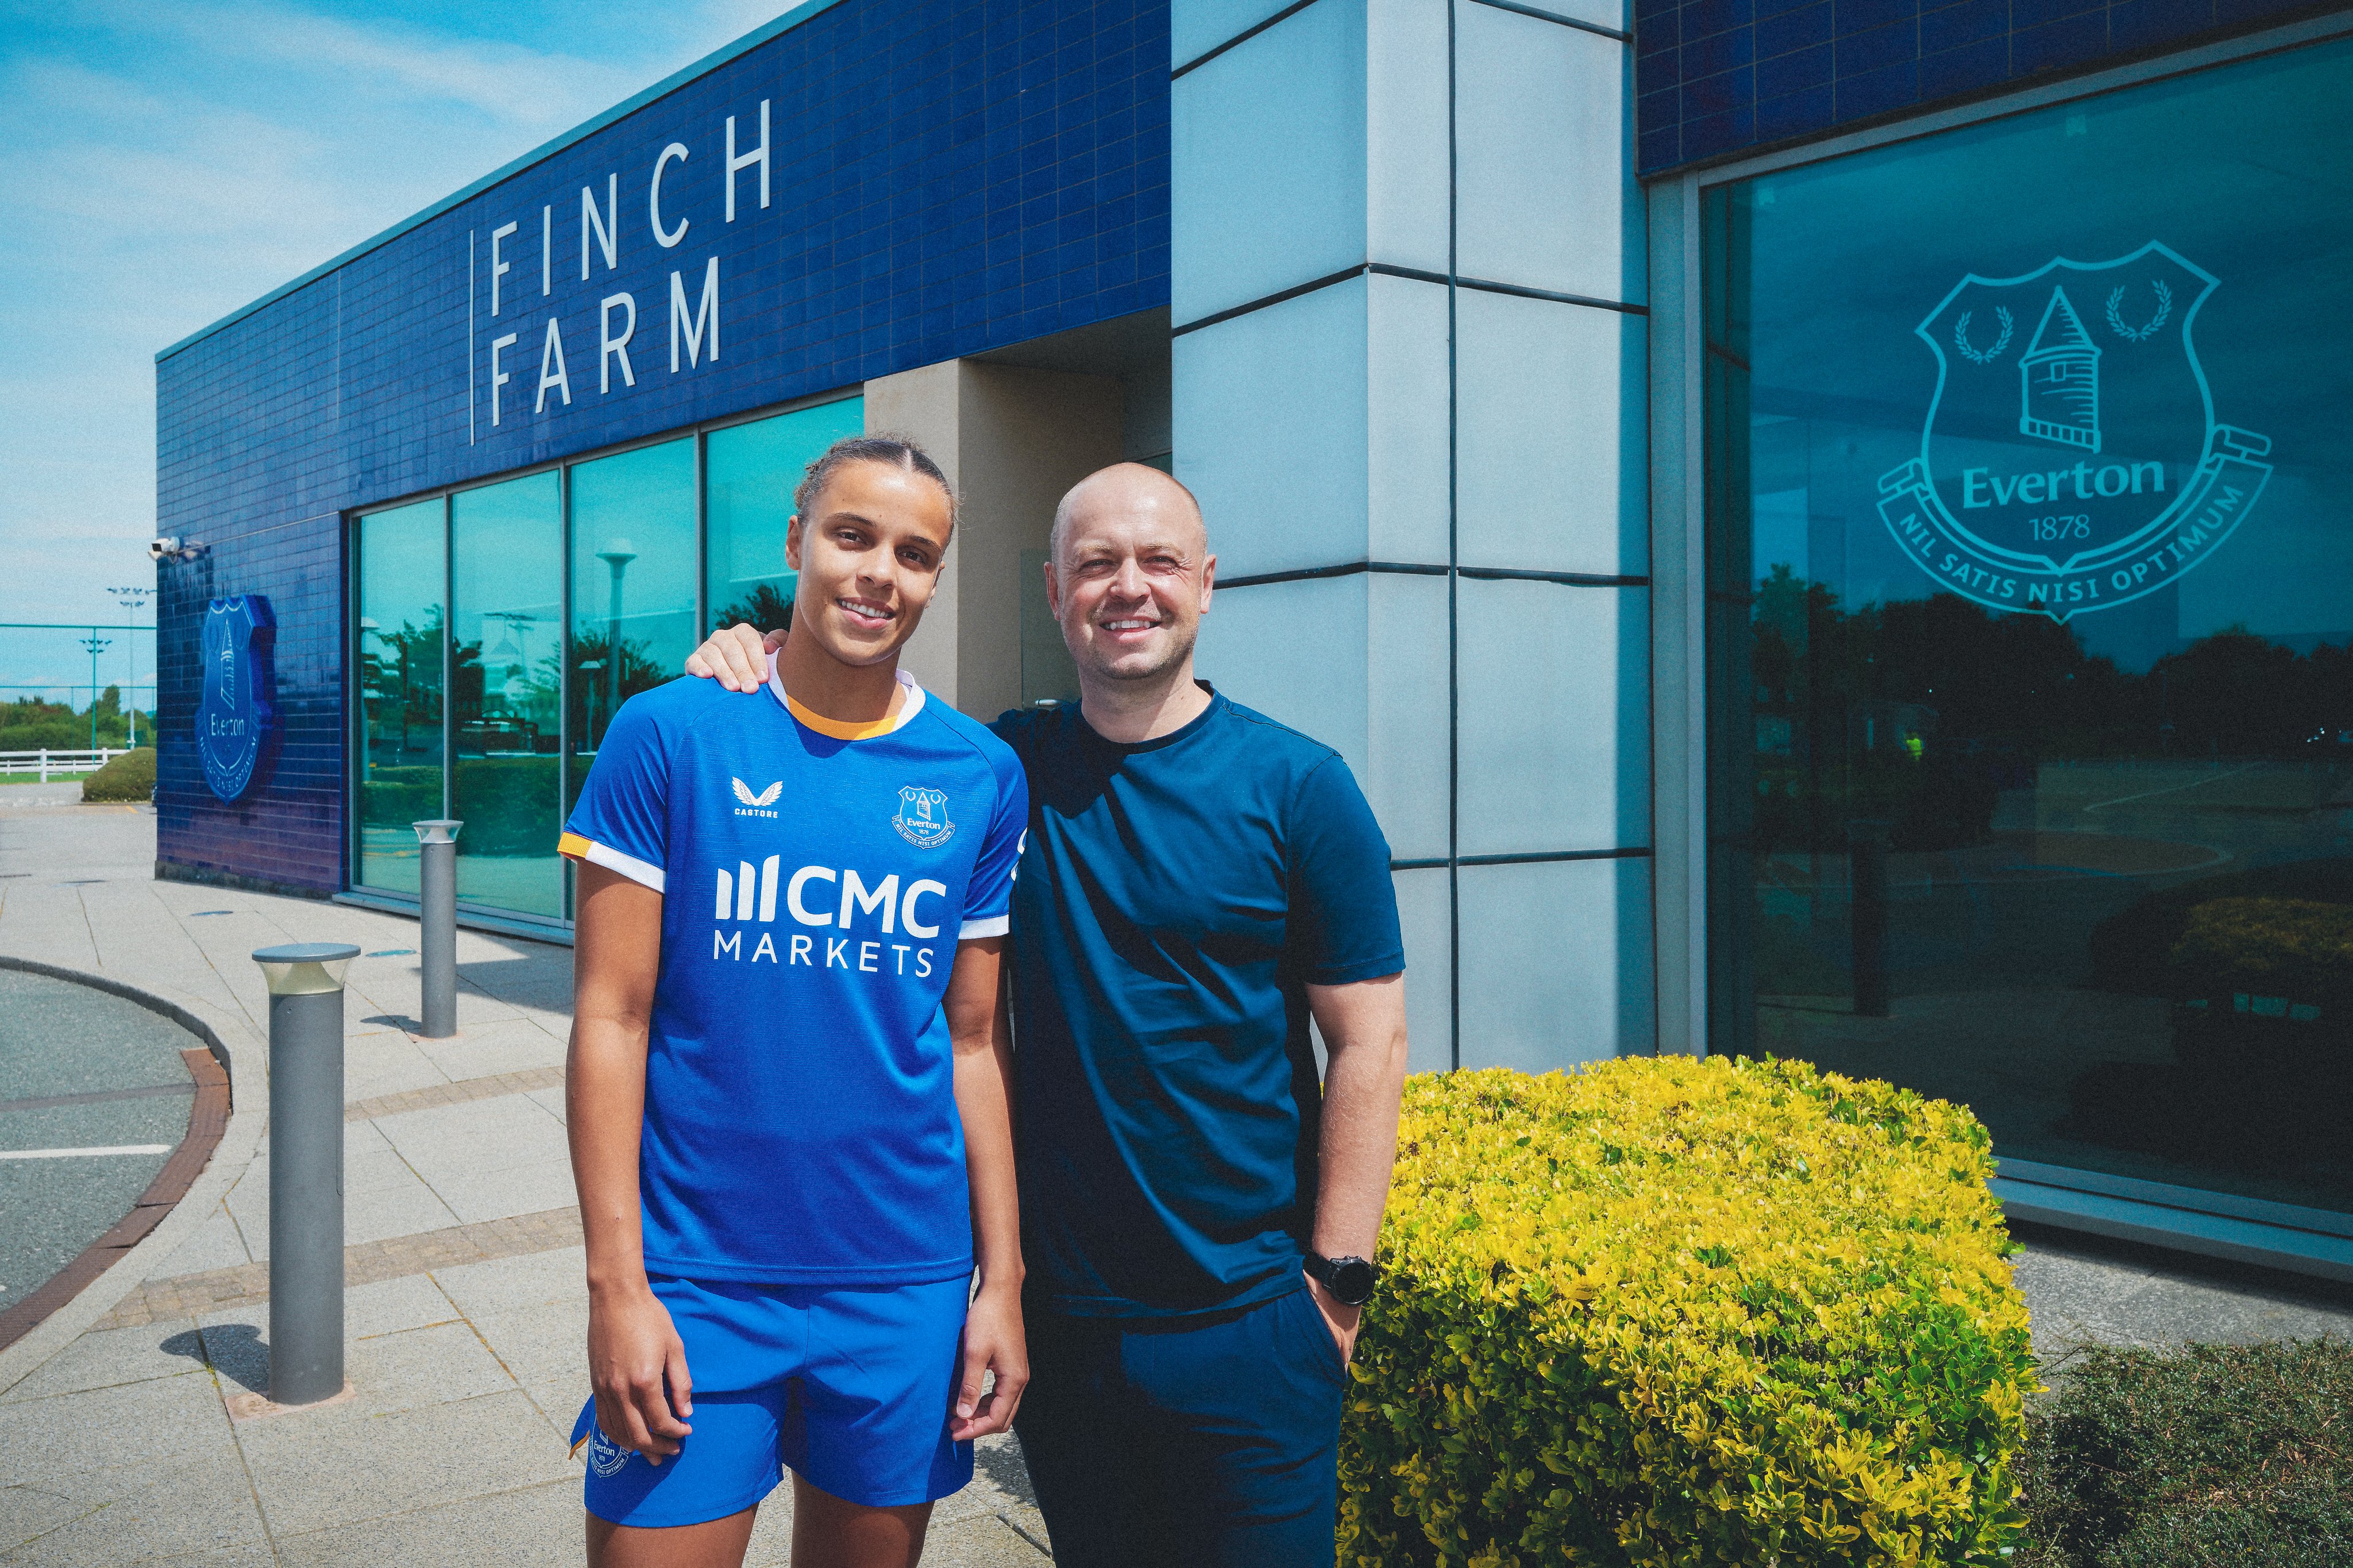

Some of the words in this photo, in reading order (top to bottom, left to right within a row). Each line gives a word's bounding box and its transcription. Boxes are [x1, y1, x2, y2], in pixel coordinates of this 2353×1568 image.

[492, 99, 770, 316] FINCH
[492, 256, 719, 427] FARM
[1962, 461, 2165, 508] Everton
[1899, 512, 1936, 558] NIL
[1939, 553, 2016, 598] SATIS
[2028, 578, 2099, 602] NISI
[2111, 485, 2243, 590] OPTIMUM
[2028, 514, 2090, 540] 1878
[735, 808, 778, 818] CASTORE
[907, 818, 940, 829] Everton
[903, 833, 917, 843] SATIS
[931, 831, 951, 845] OPTIMUM
[787, 866, 947, 939] CMC
[713, 930, 934, 978] MARKETS
[594, 1440, 615, 1456] Everton
[606, 1458, 625, 1474] OPTIMUM
